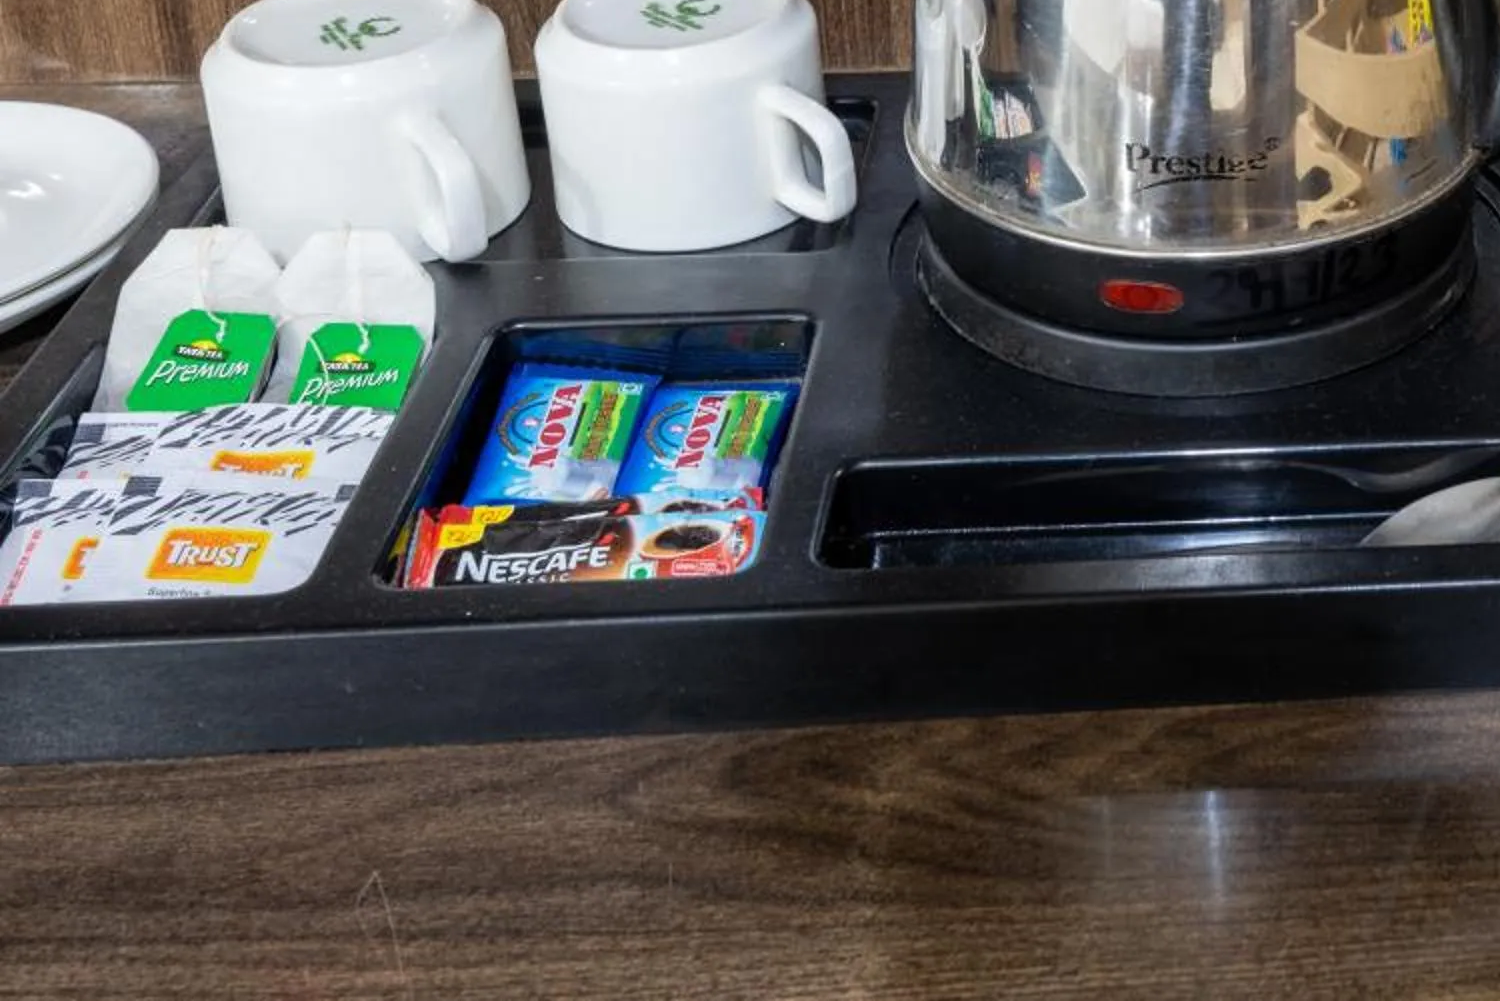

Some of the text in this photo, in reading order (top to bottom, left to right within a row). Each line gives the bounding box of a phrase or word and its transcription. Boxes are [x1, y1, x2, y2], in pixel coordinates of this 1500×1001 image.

[529, 382, 583, 468] NOVA
[676, 396, 726, 469] NOVA
[166, 539, 259, 567] TRUST
